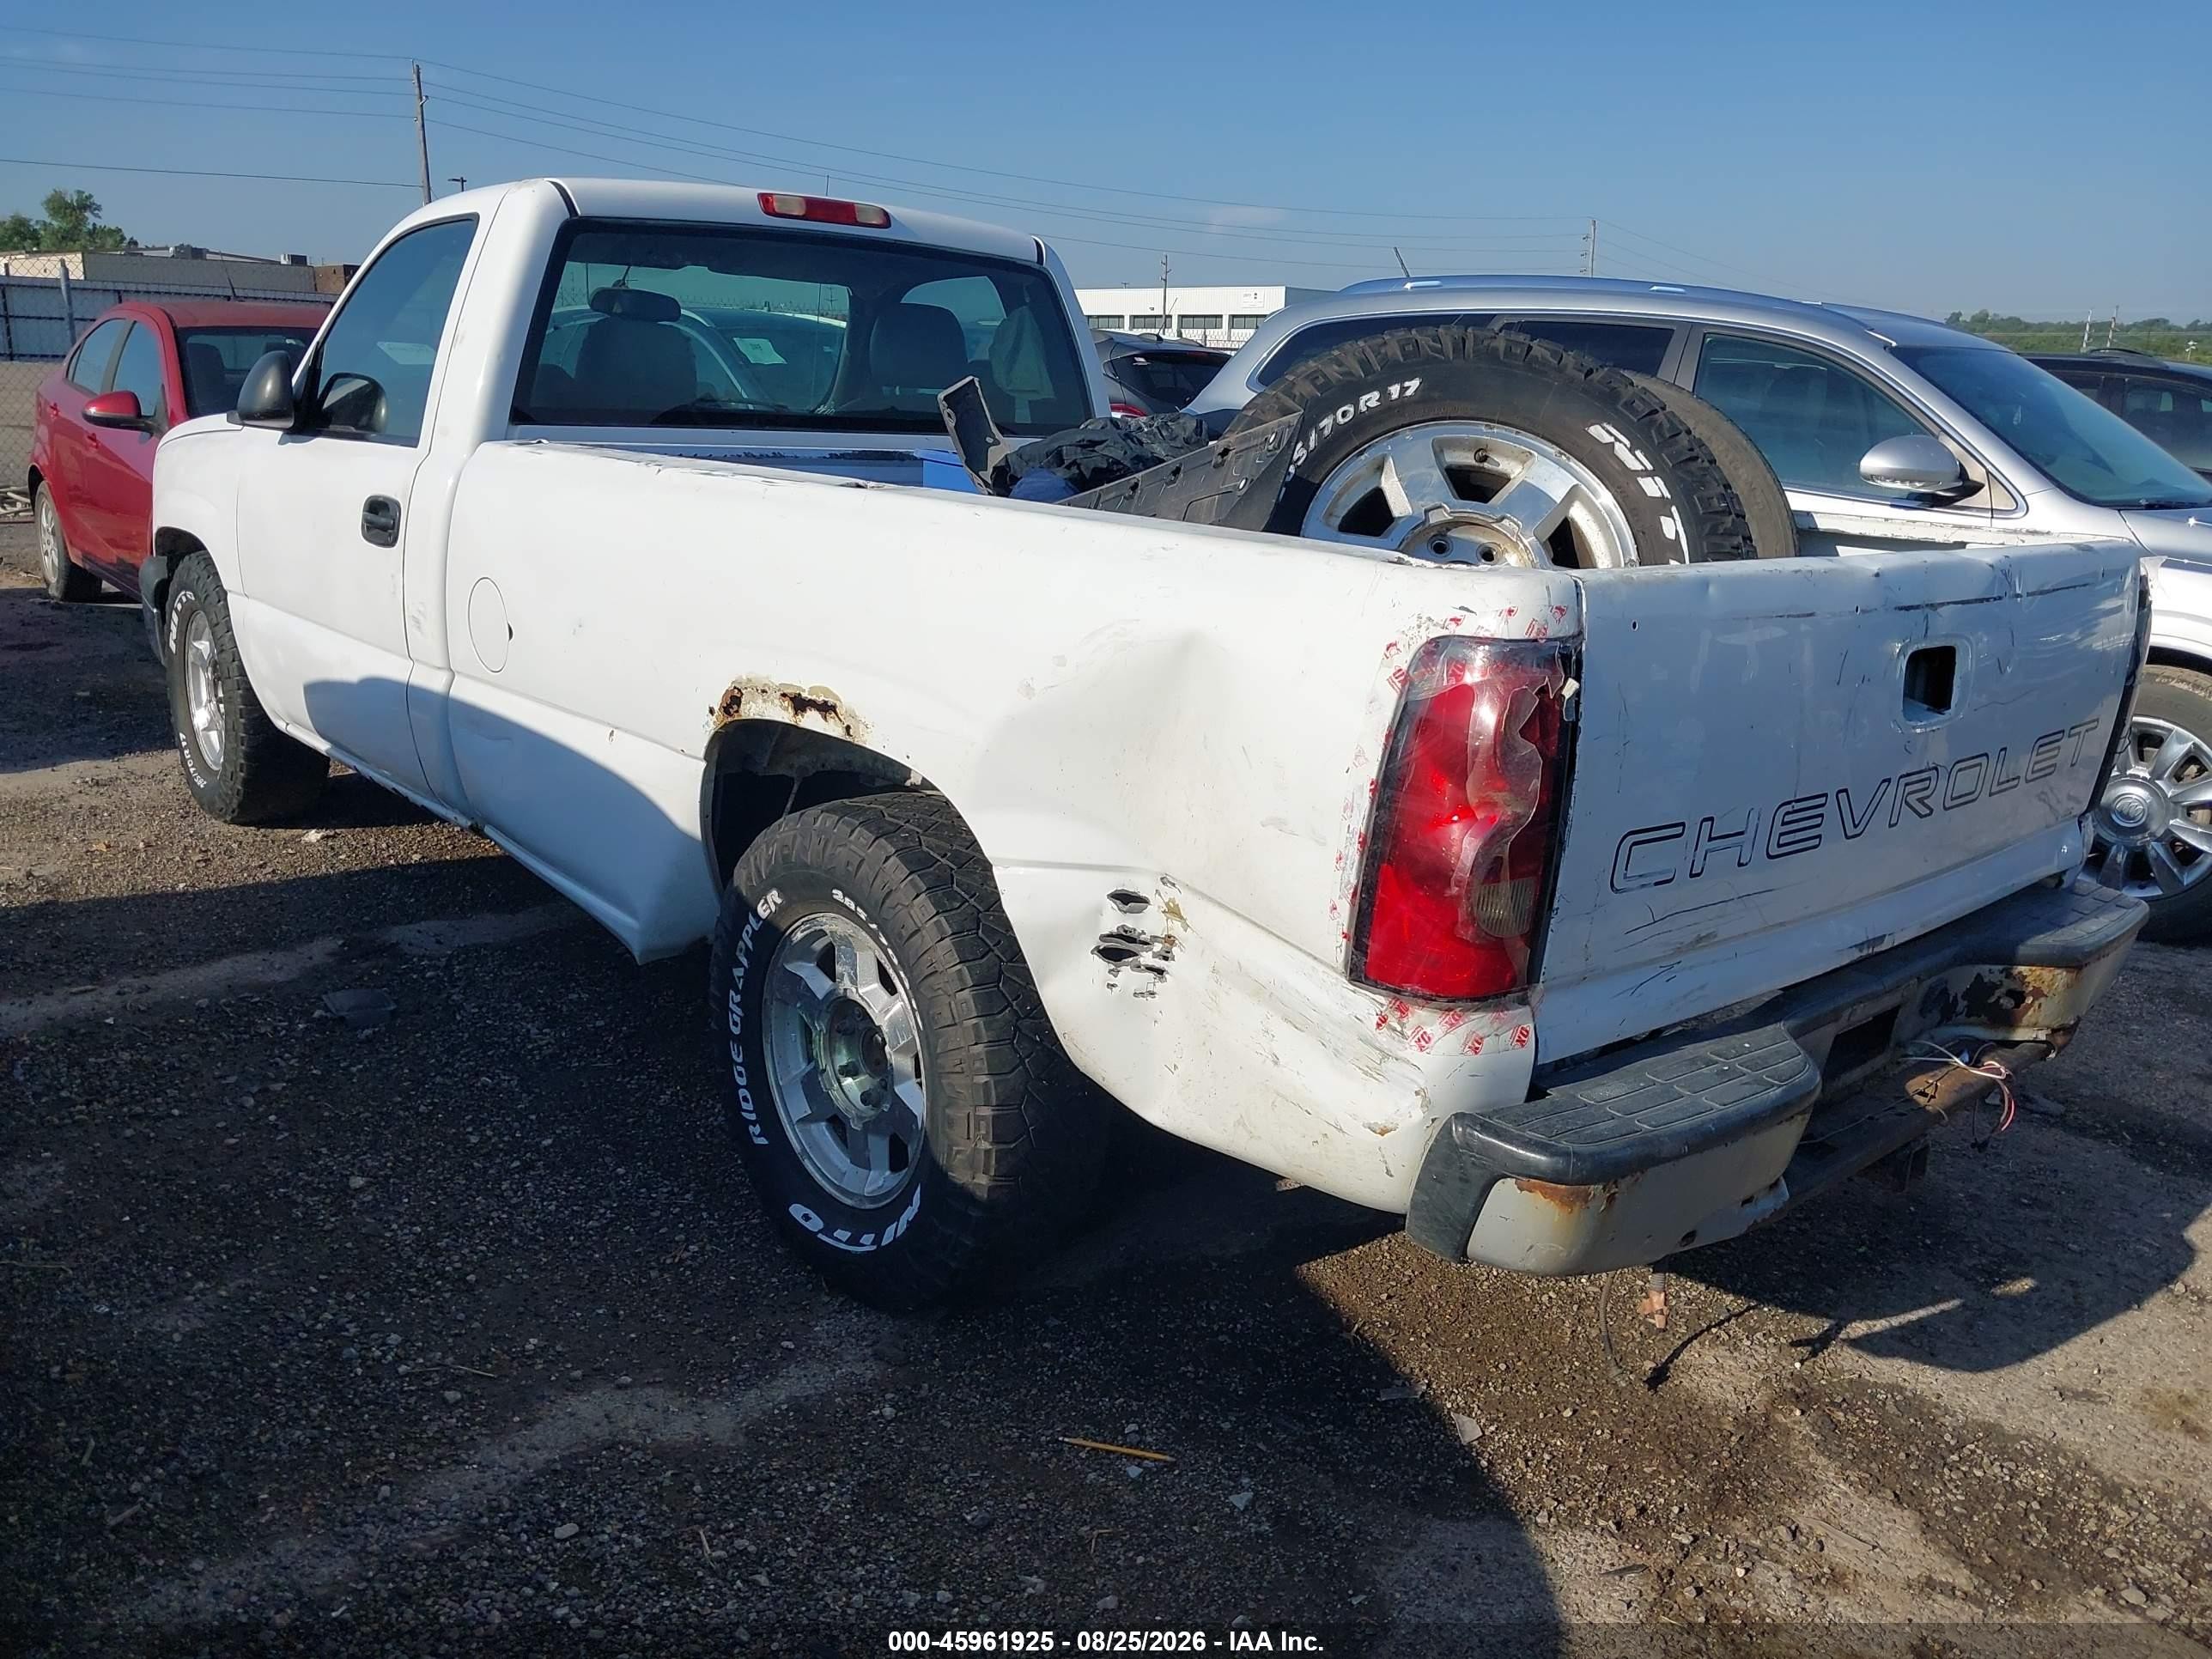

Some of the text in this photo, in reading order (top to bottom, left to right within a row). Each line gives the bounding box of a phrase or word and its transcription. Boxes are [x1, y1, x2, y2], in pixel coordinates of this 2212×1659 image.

[1609, 716, 2100, 895] CHEVROLET
[728, 887, 784, 1146] RIDGE GRAPPLER
